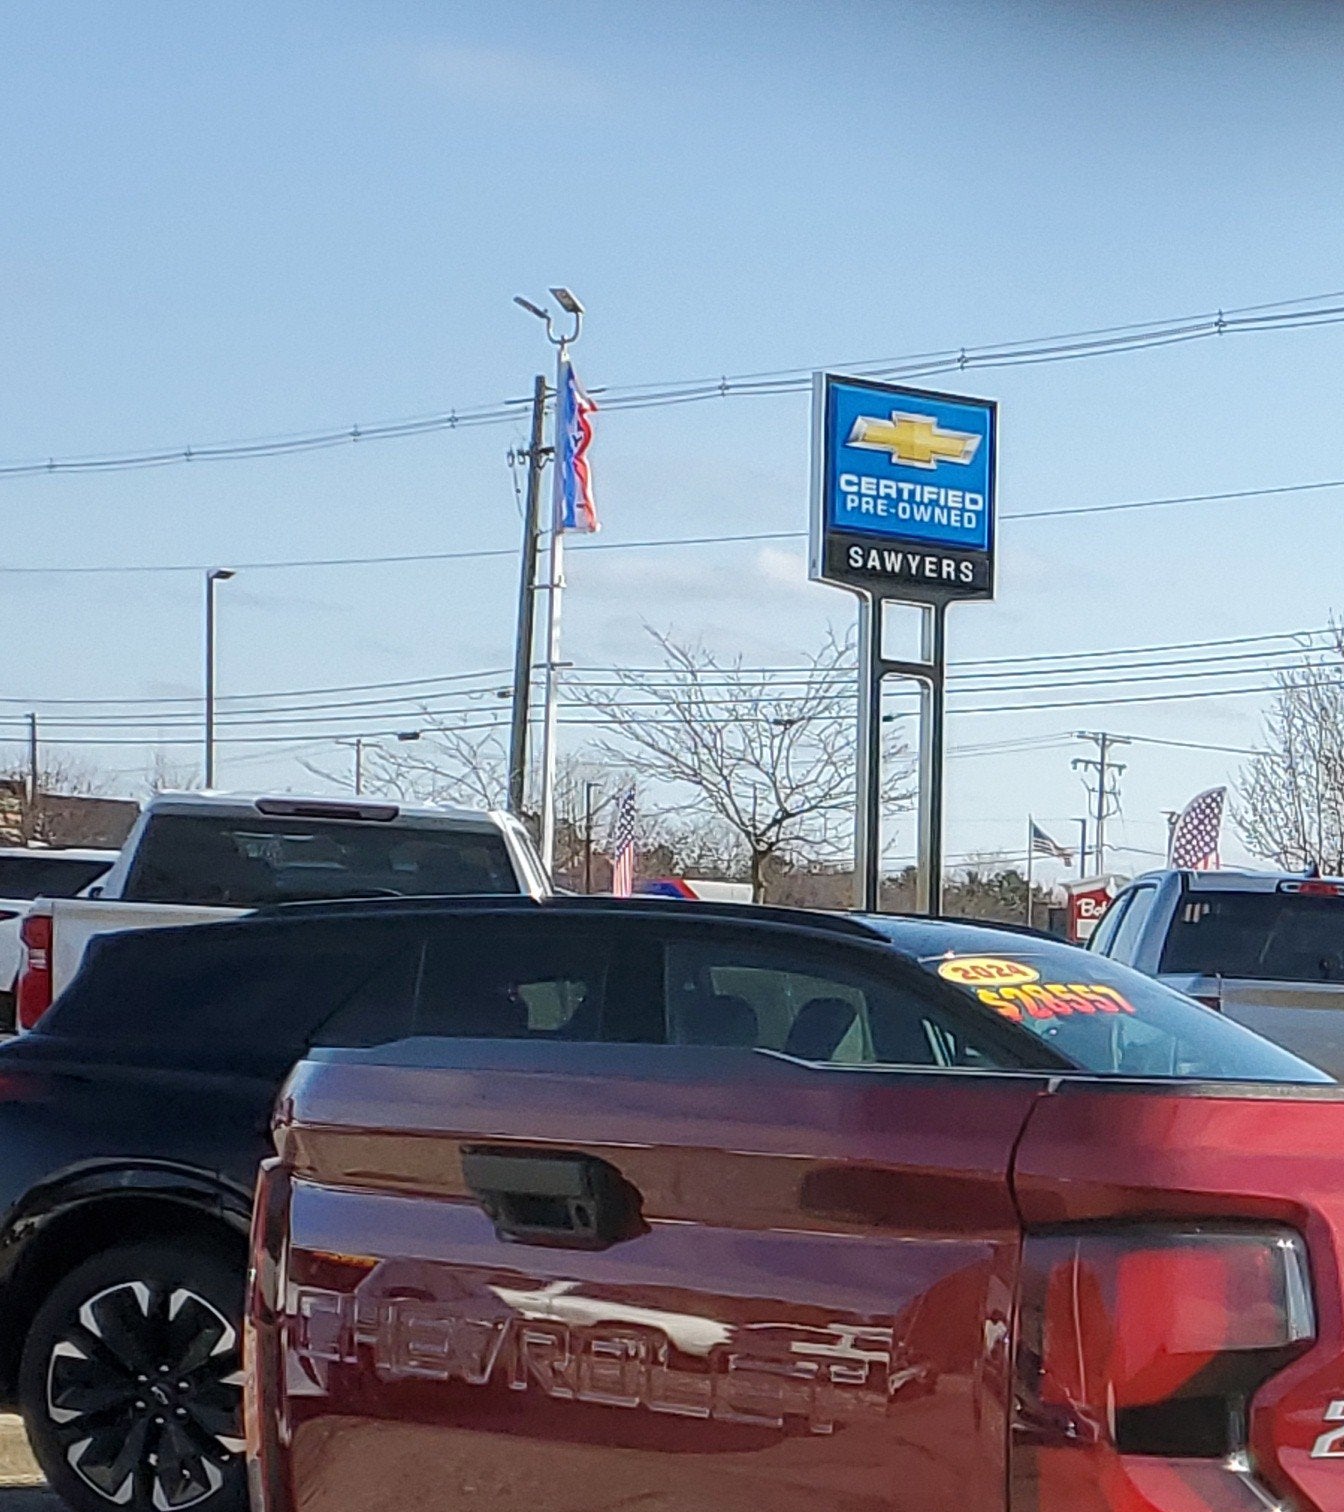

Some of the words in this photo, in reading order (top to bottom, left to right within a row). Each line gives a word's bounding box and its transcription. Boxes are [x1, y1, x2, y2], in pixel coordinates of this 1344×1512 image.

[839, 473, 984, 511] CERTIFIED
[846, 494, 977, 529] PRE-OWNED
[849, 546, 974, 582] SAWYERS
[951, 964, 1029, 981] 2024
